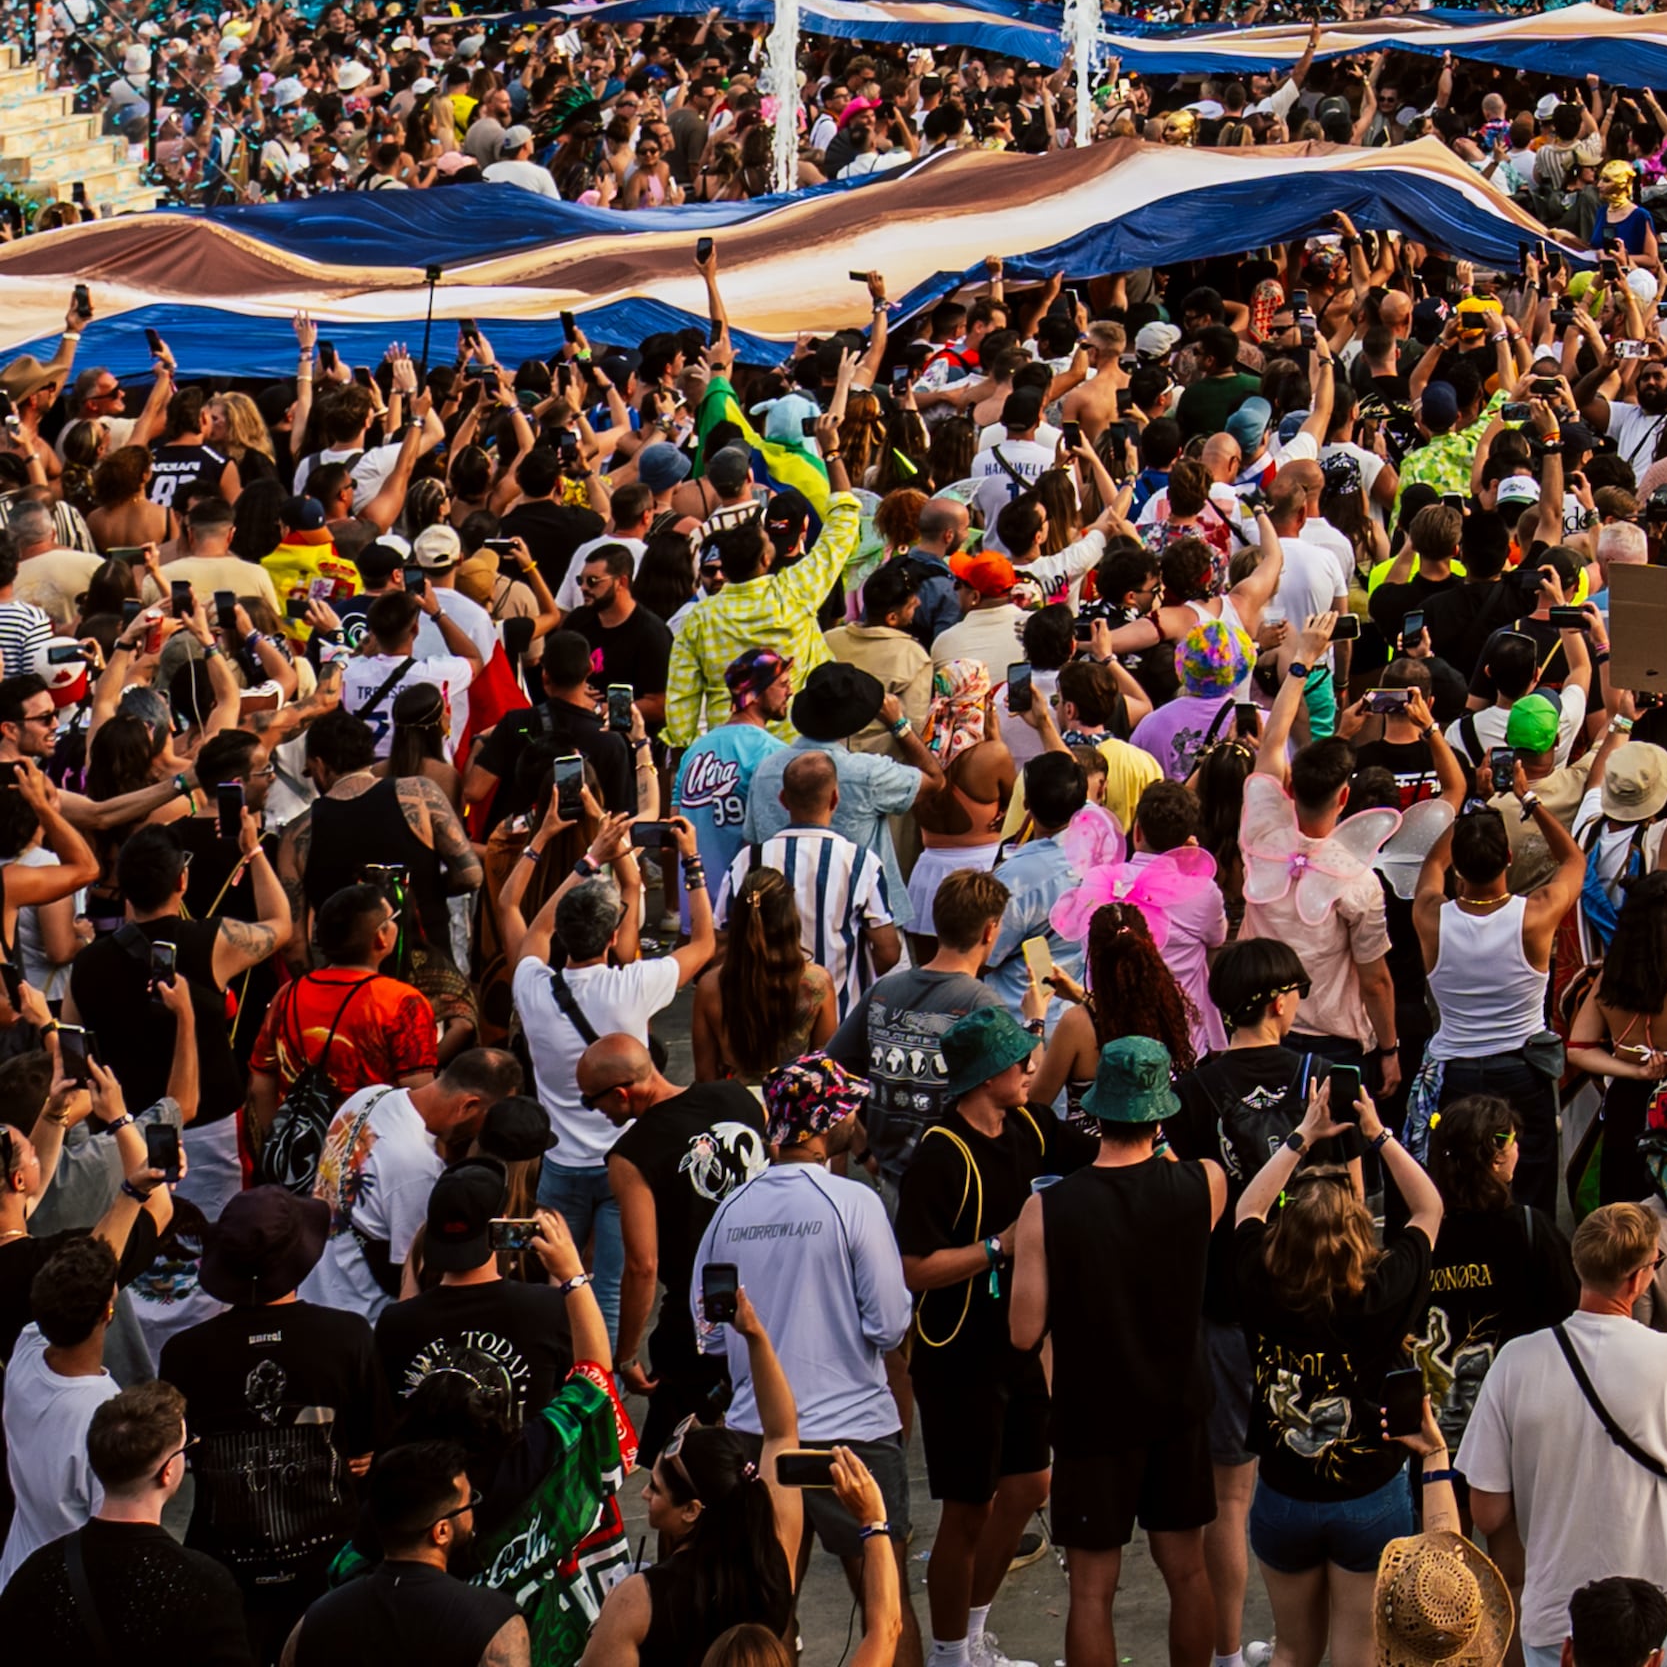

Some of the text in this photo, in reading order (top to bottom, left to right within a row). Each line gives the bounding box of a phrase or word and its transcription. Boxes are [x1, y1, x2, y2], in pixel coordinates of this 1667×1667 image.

[985, 462, 1044, 476] HARWELL
[712, 795, 745, 826] 39
[726, 1220, 823, 1244] TOMORROWLAND
[248, 1330, 283, 1345] unreal
